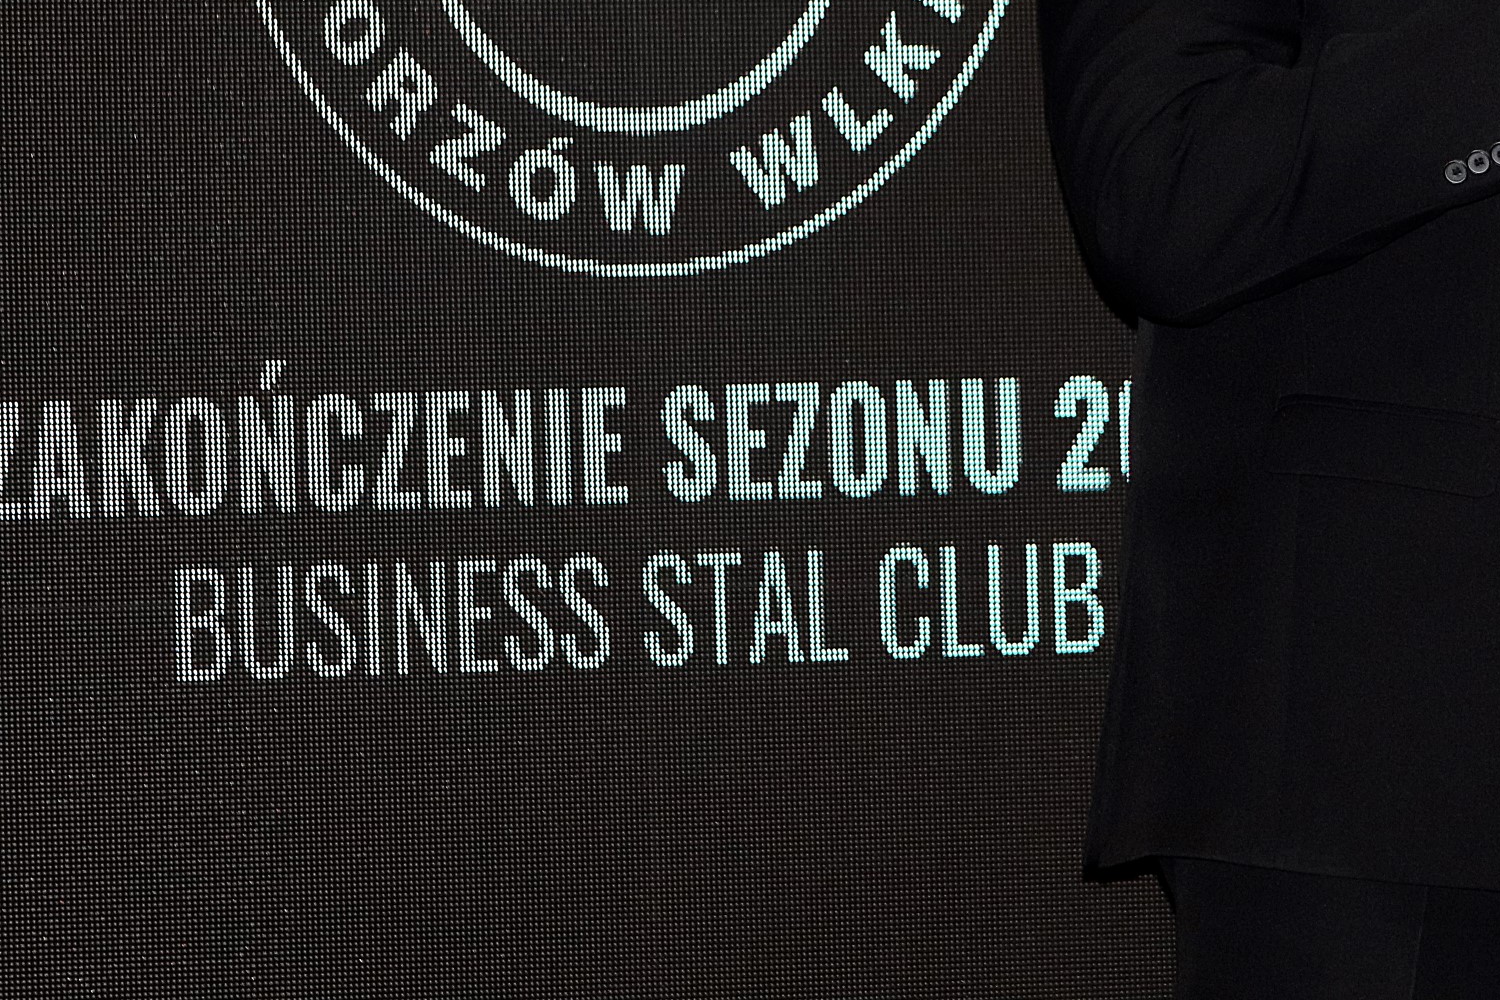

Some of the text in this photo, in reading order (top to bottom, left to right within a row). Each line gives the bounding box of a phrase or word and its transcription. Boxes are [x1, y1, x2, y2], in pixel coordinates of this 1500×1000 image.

[660, 376, 1023, 503] SEZONU
[174, 541, 1105, 682] BUSINESS STAL CLUB
